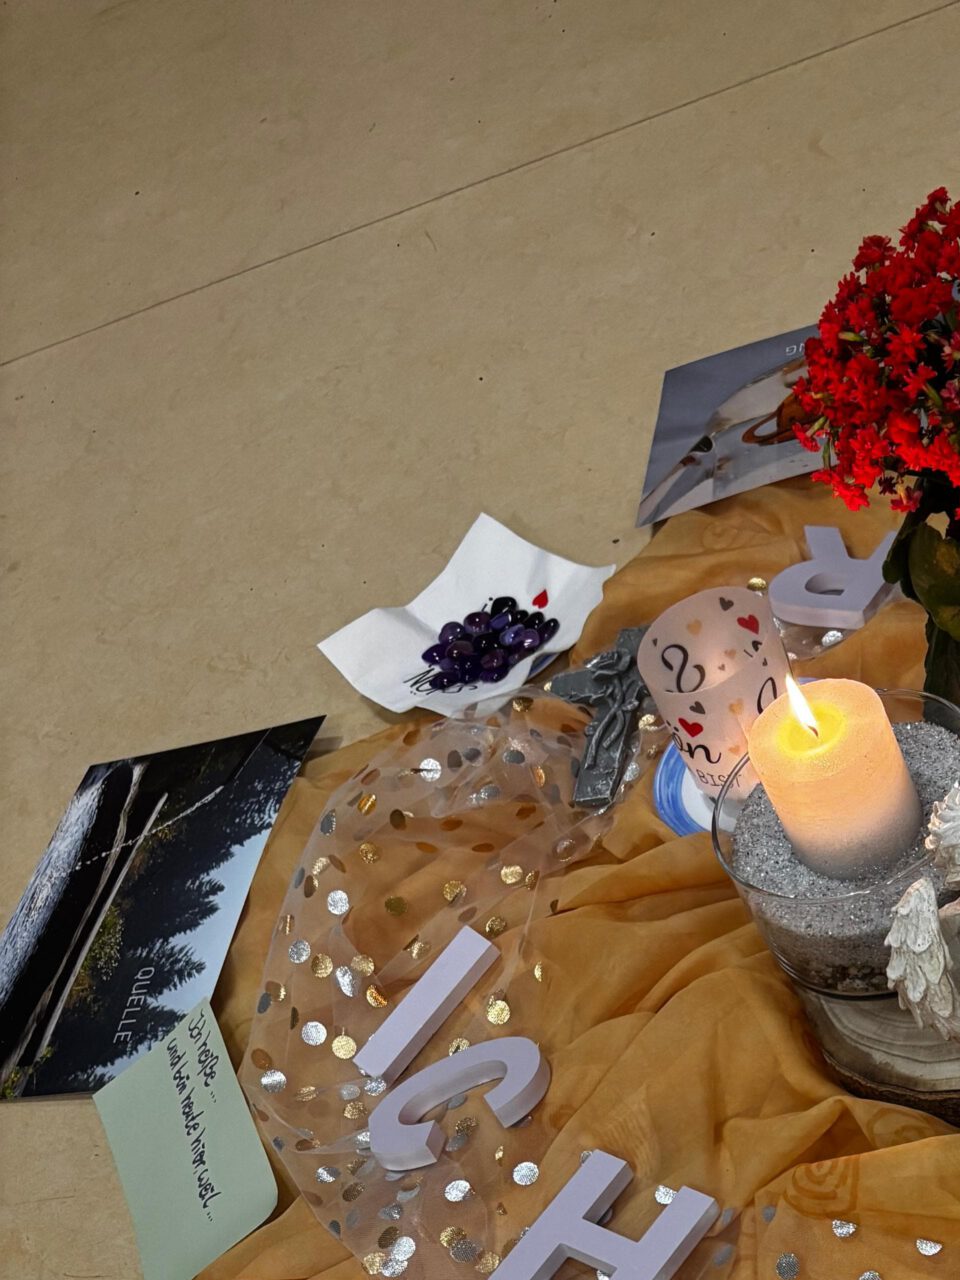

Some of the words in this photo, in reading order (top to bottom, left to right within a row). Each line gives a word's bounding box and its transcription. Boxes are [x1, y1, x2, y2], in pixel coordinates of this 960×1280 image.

[112, 966, 156, 1045] QUELLE
[188, 1008, 207, 1045] Ich
[167, 1037, 187, 1071] und
[172, 1060, 190, 1096] bin
[181, 1086, 205, 1136] heute
